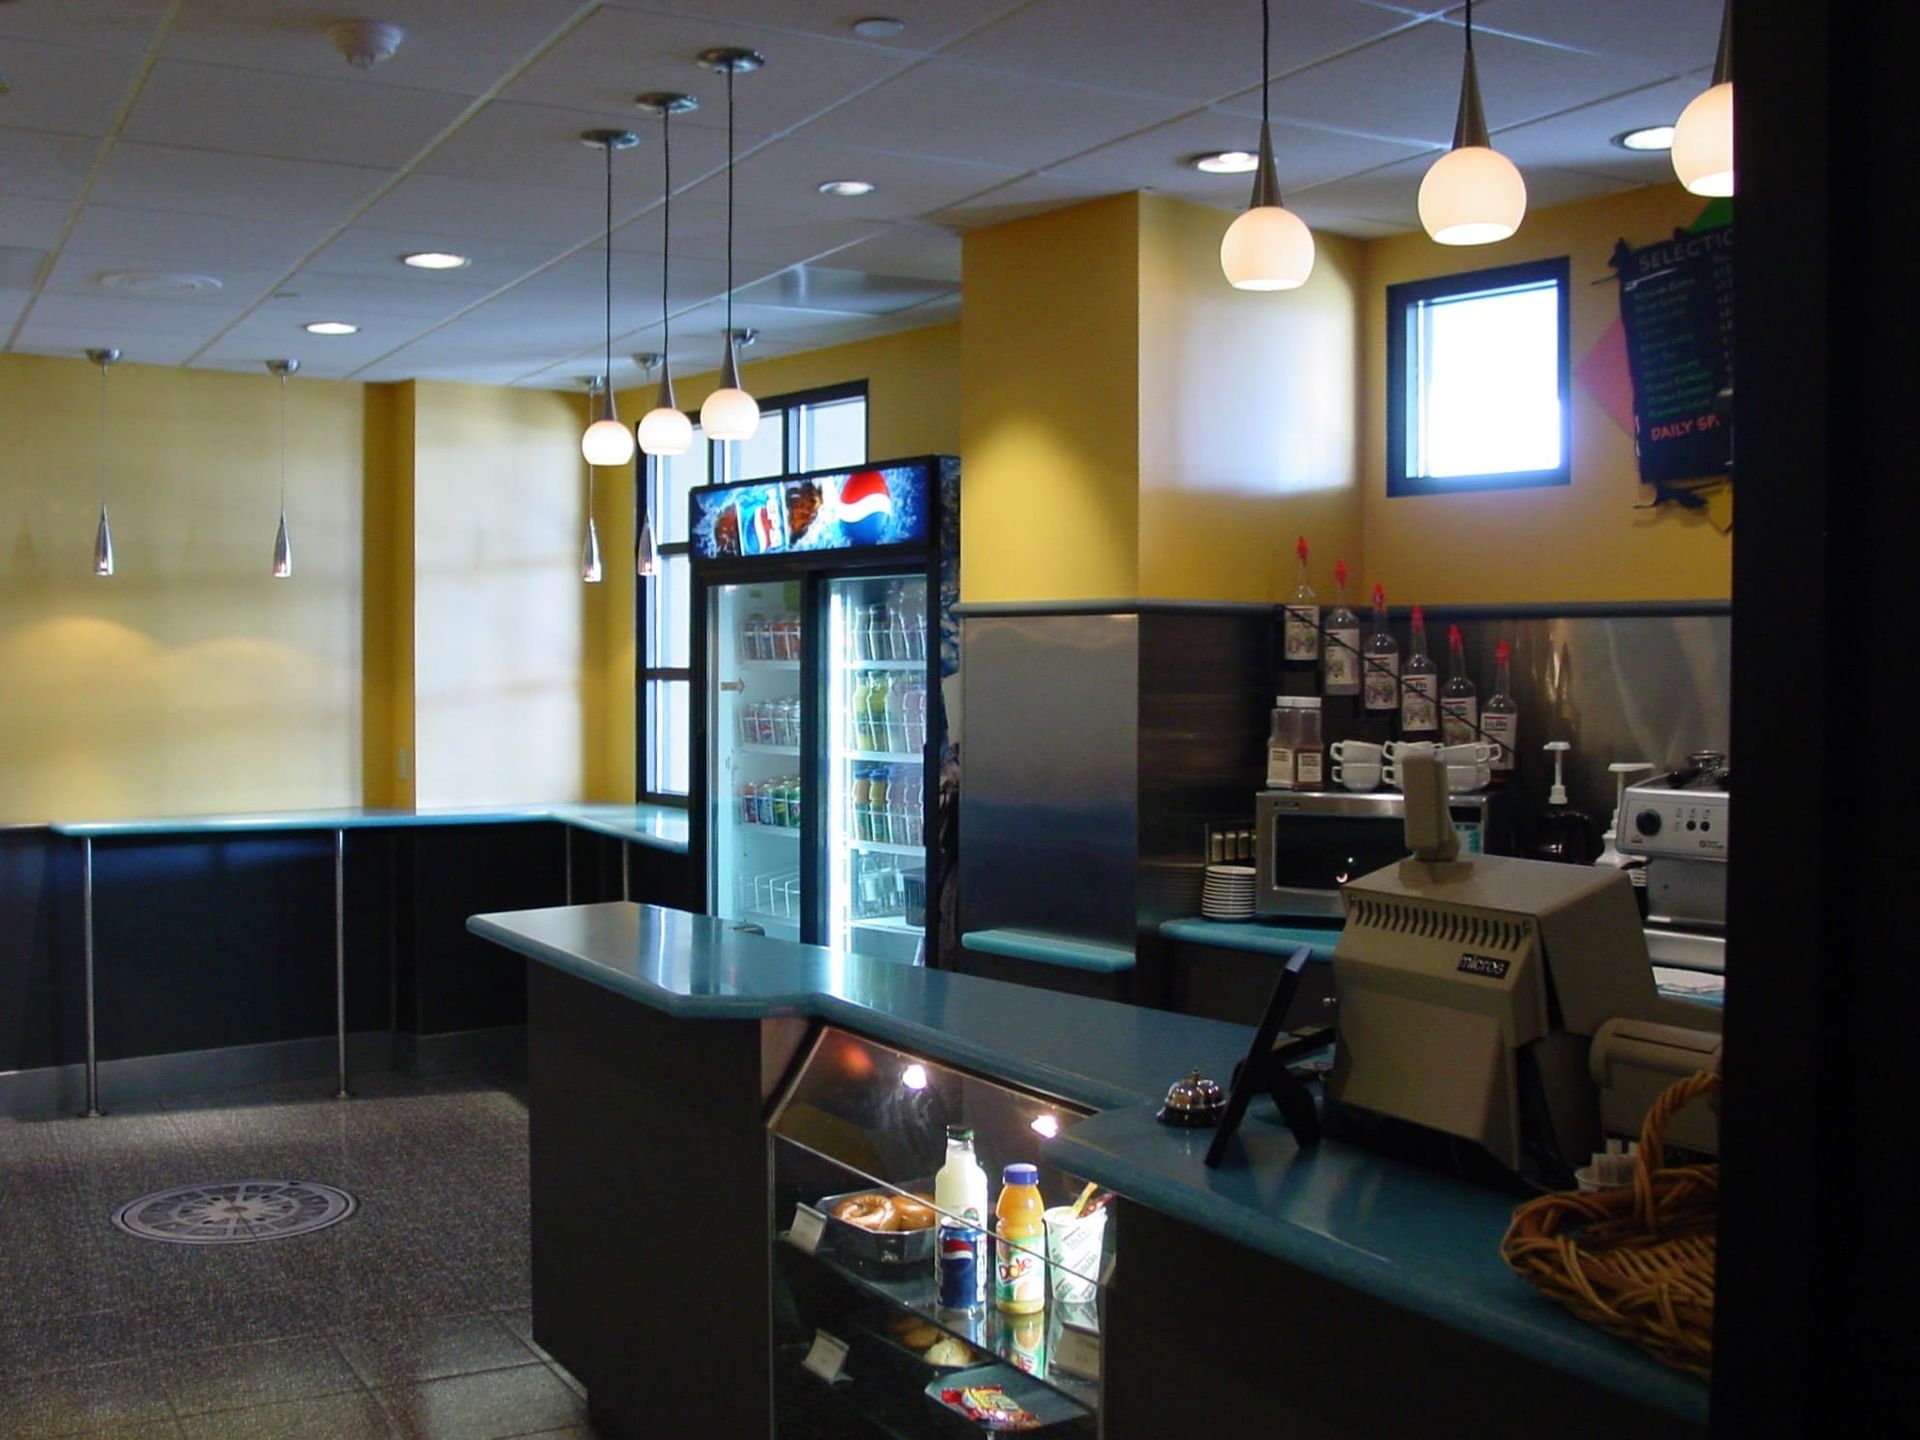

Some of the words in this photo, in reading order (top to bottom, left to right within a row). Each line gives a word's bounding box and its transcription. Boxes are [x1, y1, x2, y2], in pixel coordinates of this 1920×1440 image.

[1651, 419, 1693, 442] DAILY
[1461, 955, 1505, 976] micros
[997, 1257, 1033, 1282] Dole
